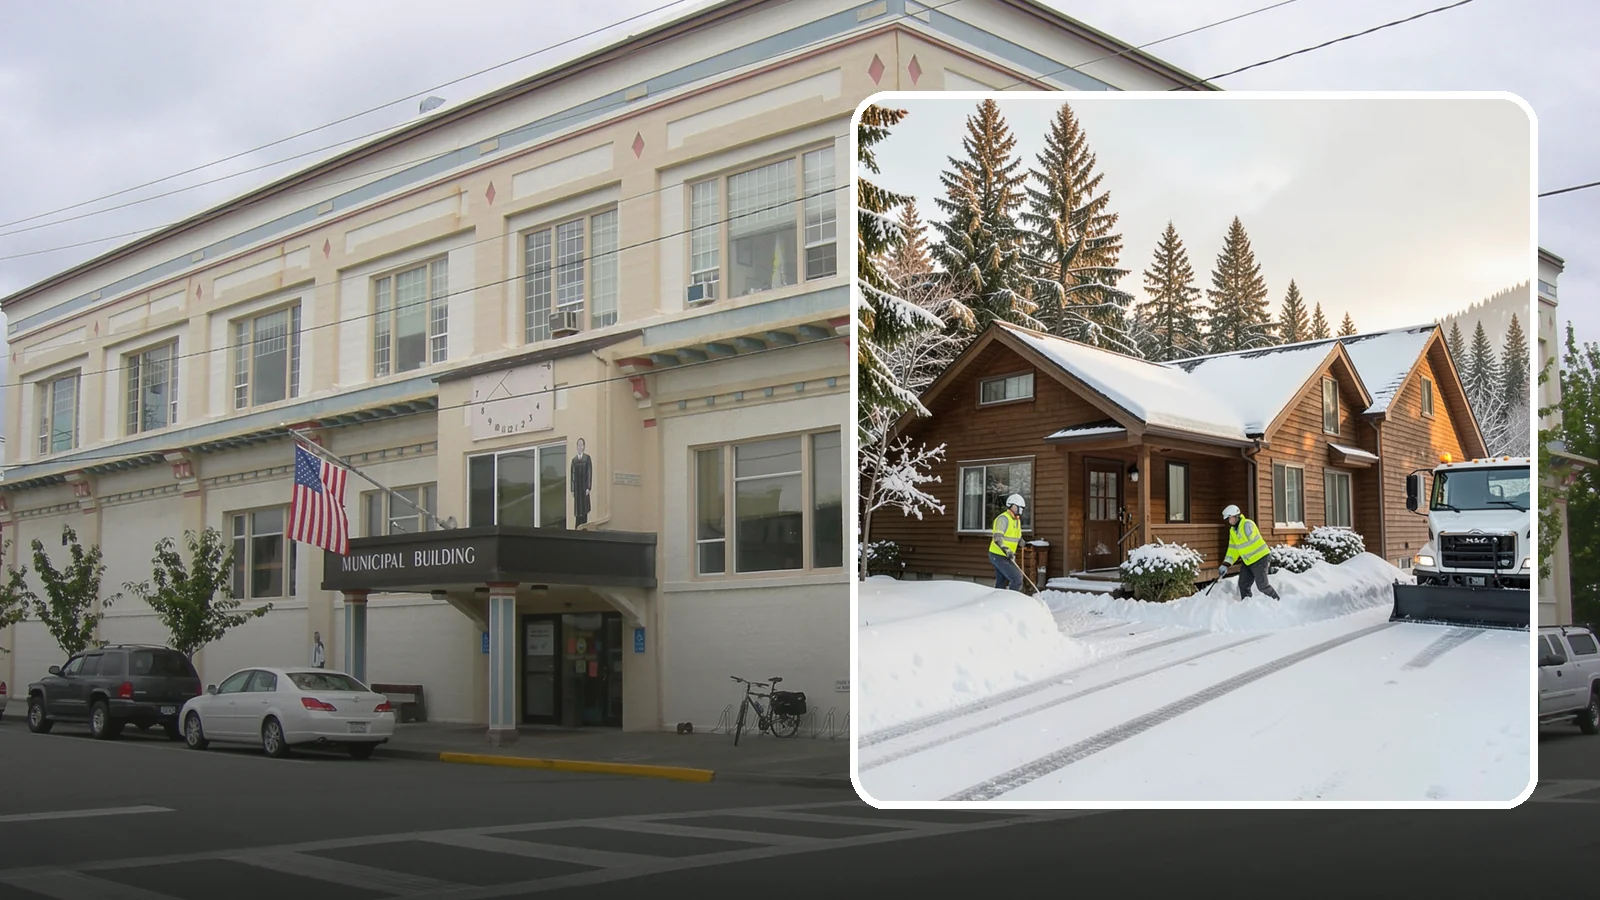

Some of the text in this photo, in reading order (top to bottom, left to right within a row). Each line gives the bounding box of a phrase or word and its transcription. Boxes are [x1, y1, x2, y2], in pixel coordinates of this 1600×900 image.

[480, 407, 485, 415] 8
[488, 418, 492, 426] 9
[529, 414, 533, 422] 3
[521, 420, 525, 428] 2
[342, 547, 475, 571] MUNICIPAL BUILDING
